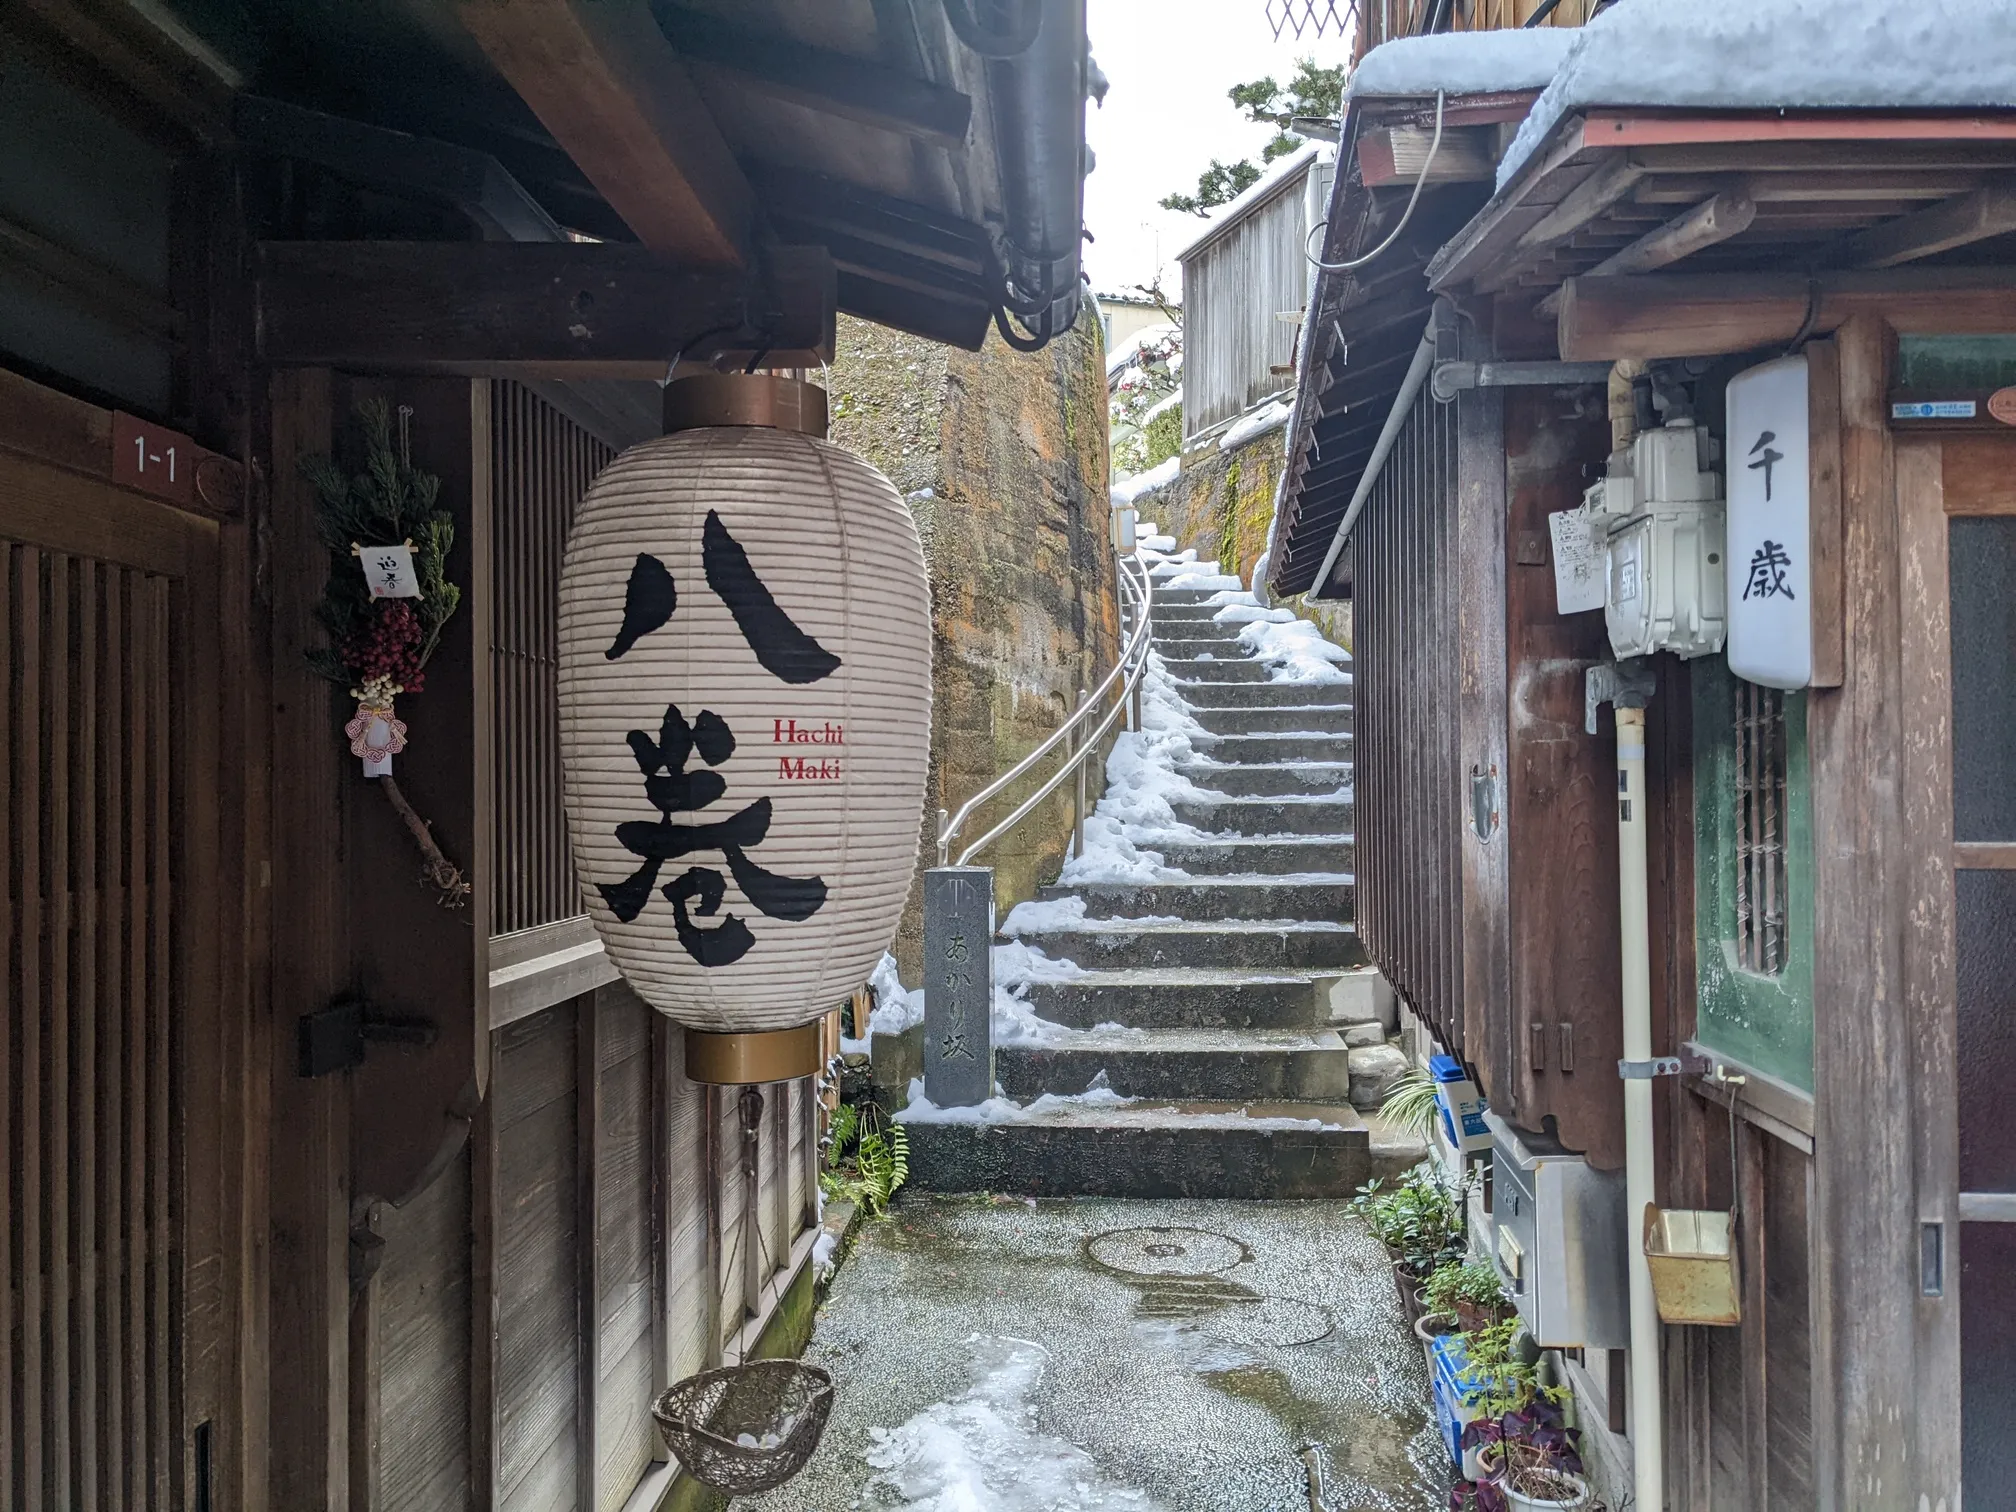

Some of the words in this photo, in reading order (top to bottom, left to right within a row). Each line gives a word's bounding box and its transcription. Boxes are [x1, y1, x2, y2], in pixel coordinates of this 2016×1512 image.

[135, 436, 175, 482] 1-1
[1743, 430, 1795, 601] 千歳
[773, 719, 843, 744] Hachi
[778, 756, 840, 780] Maki
[941, 931, 975, 1060] あかり坂
